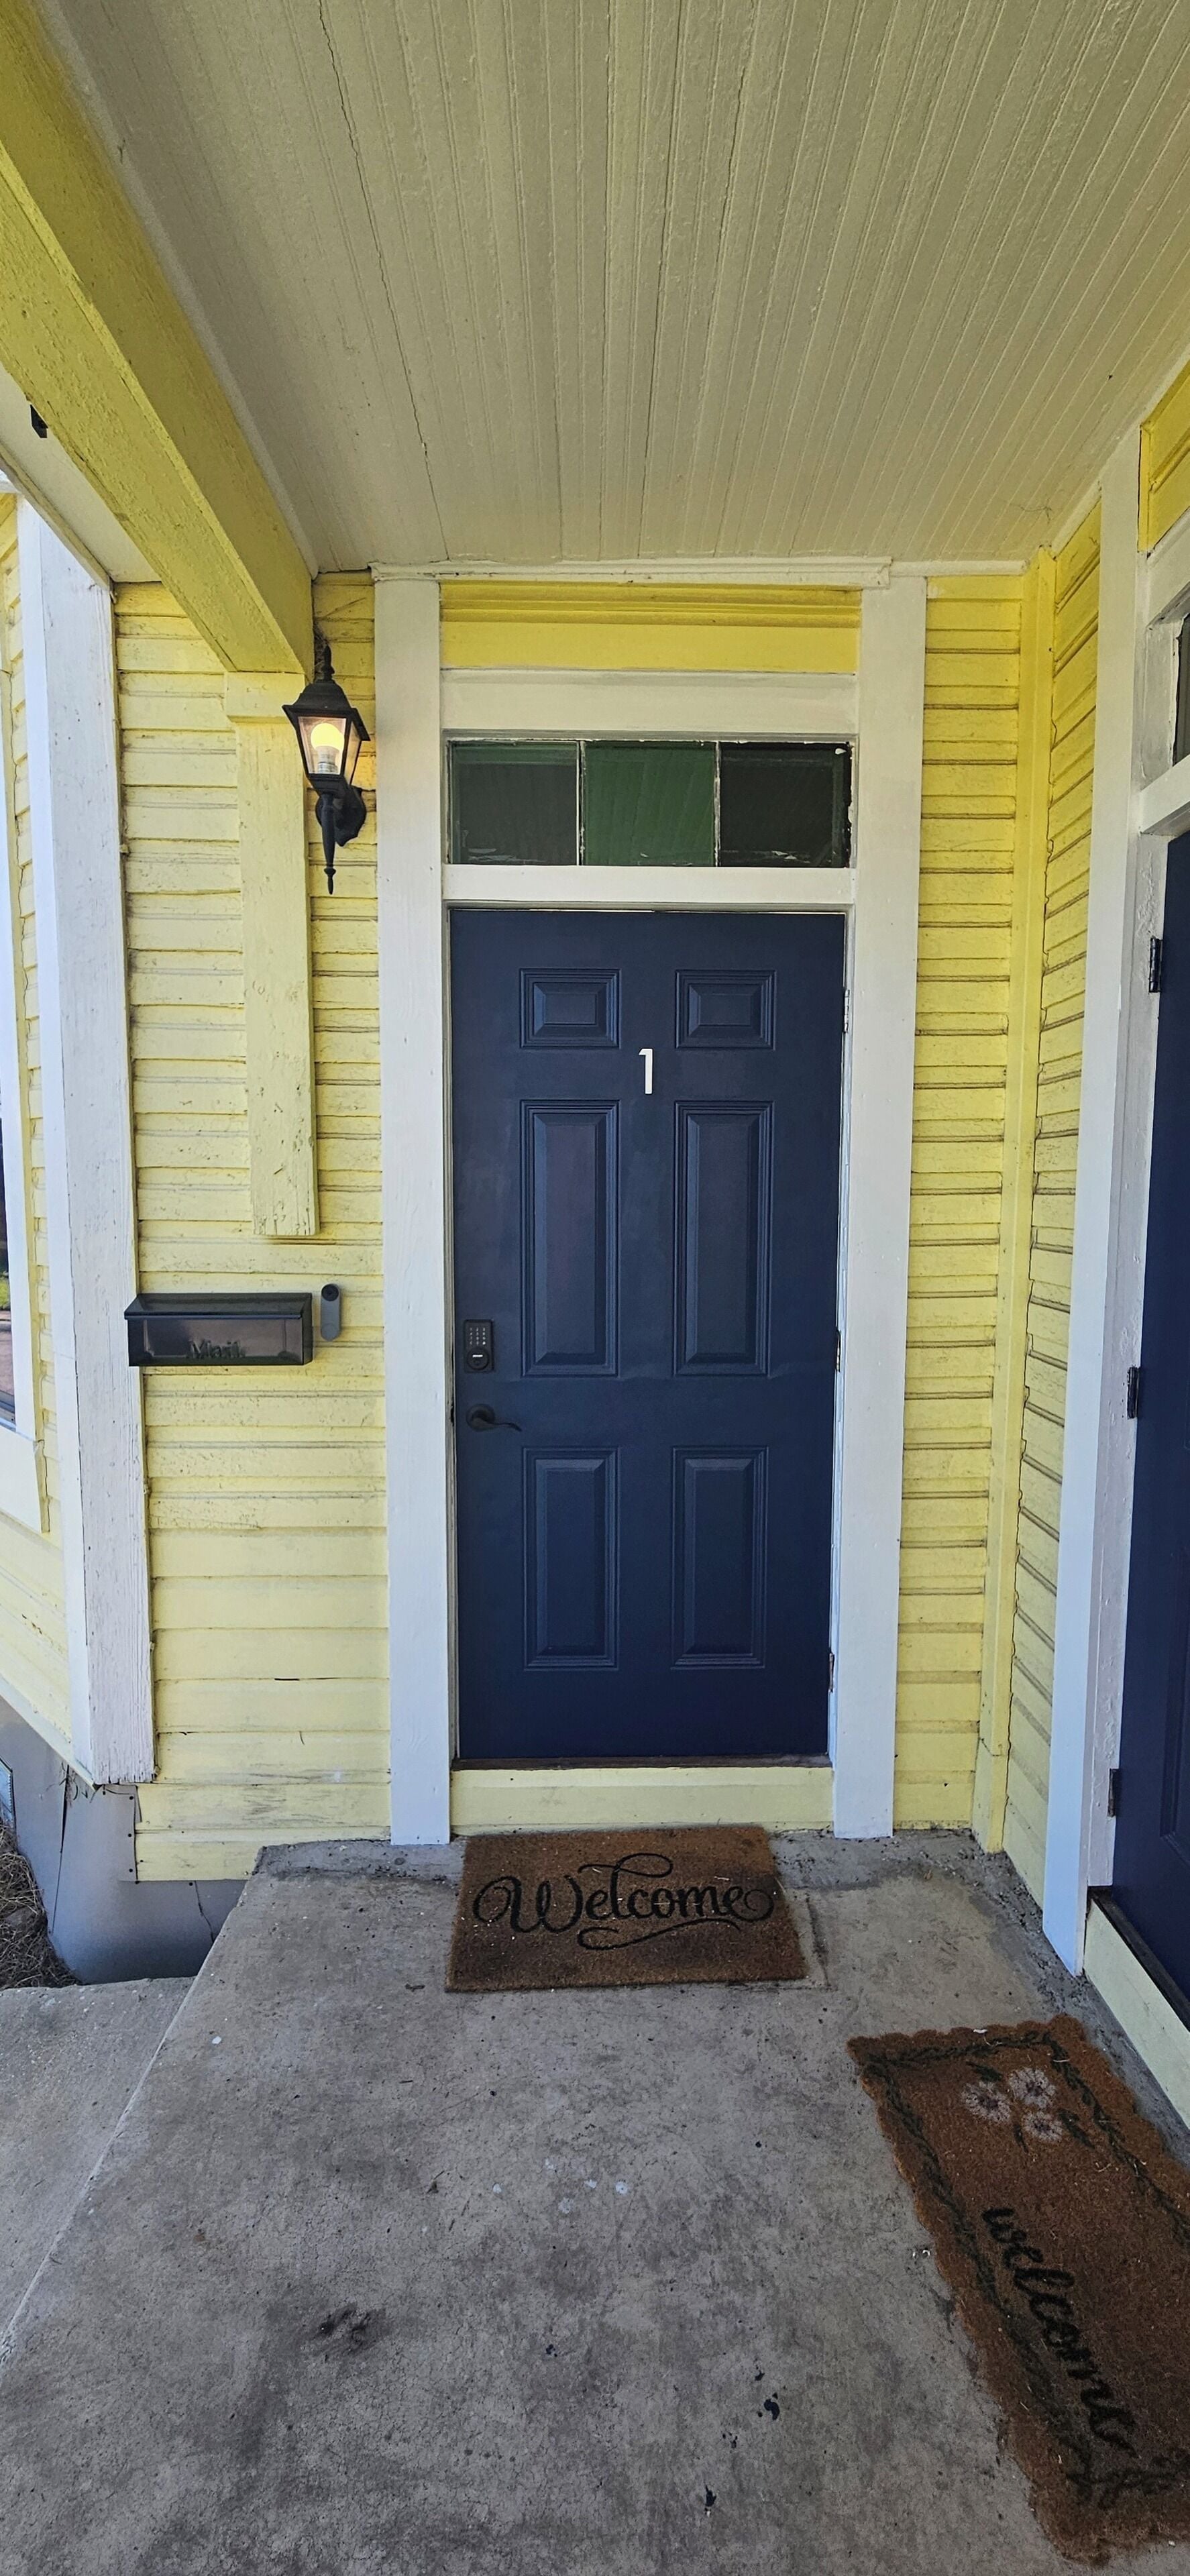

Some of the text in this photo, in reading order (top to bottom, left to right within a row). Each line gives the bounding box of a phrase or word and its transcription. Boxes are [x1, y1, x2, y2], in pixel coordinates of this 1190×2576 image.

[639, 1049, 653, 1094] 1
[188, 1338, 244, 1358] Mail
[472, 1853, 774, 1934] Welcome
[983, 2206, 1139, 2459] welcome
